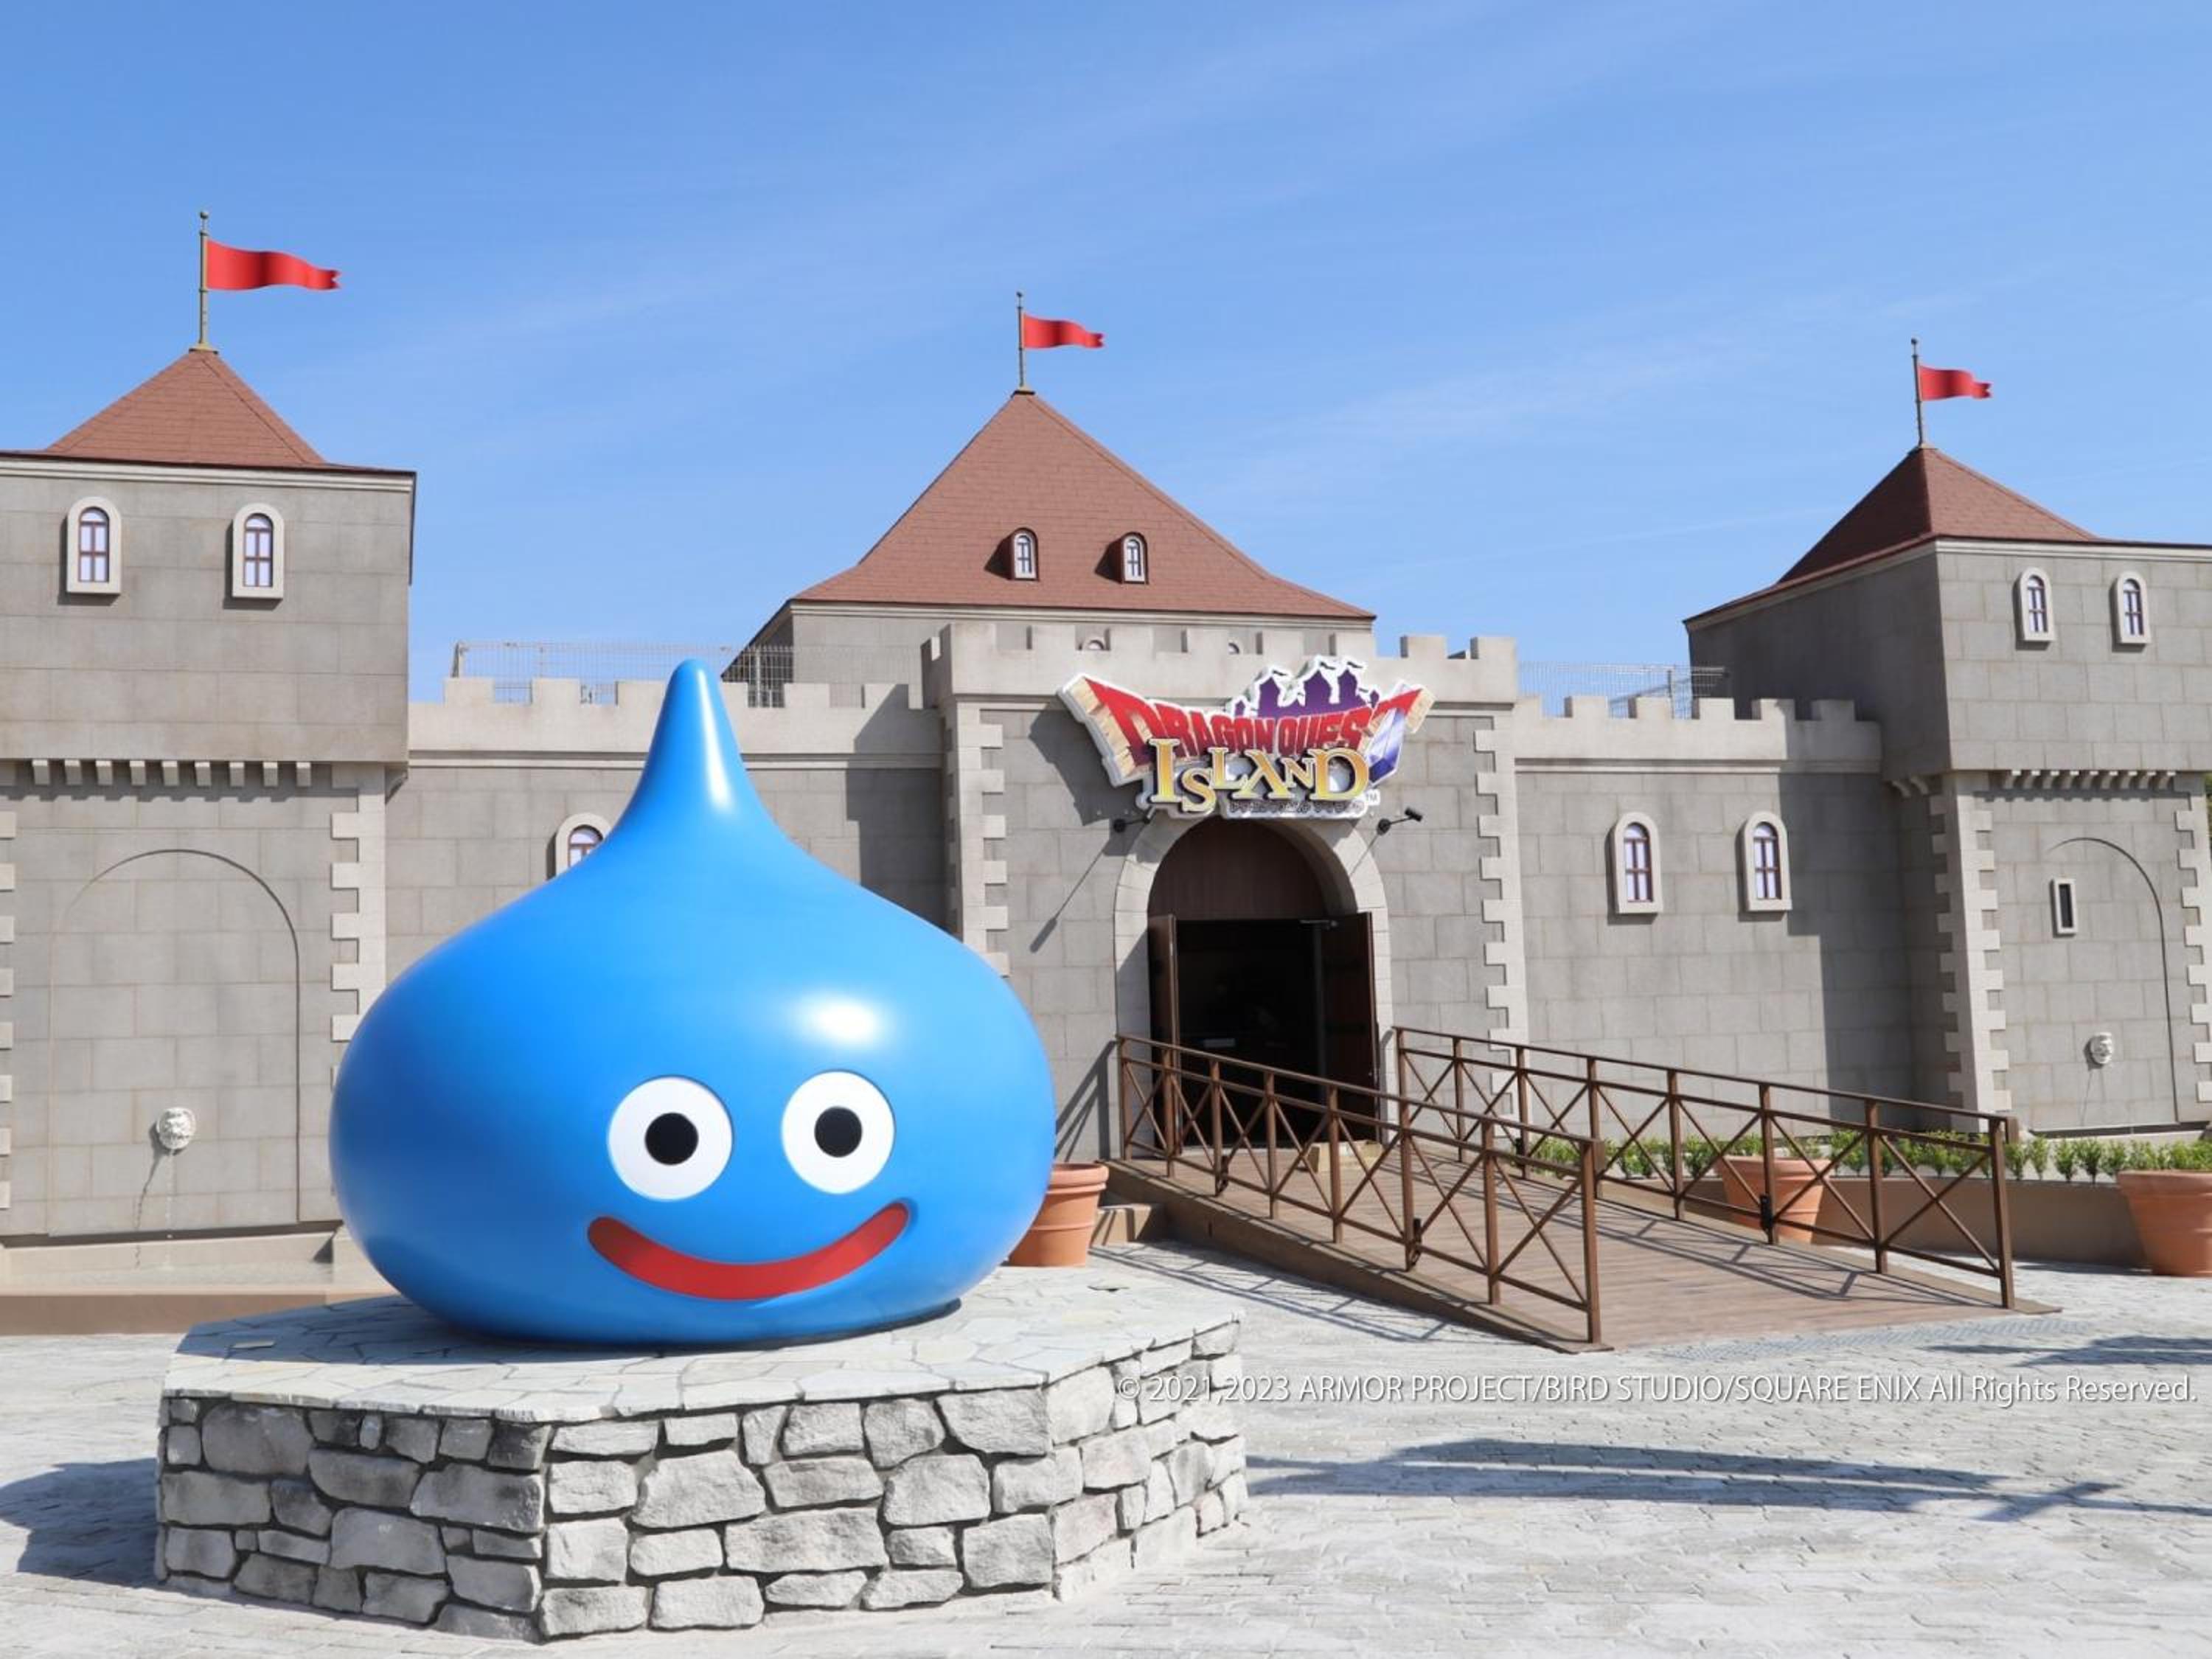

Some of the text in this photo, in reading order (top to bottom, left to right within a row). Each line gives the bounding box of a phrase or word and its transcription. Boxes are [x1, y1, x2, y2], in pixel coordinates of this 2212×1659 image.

[1085, 677, 1422, 768] DRAGON QUEST
[1149, 737, 1369, 811] ISLAND
